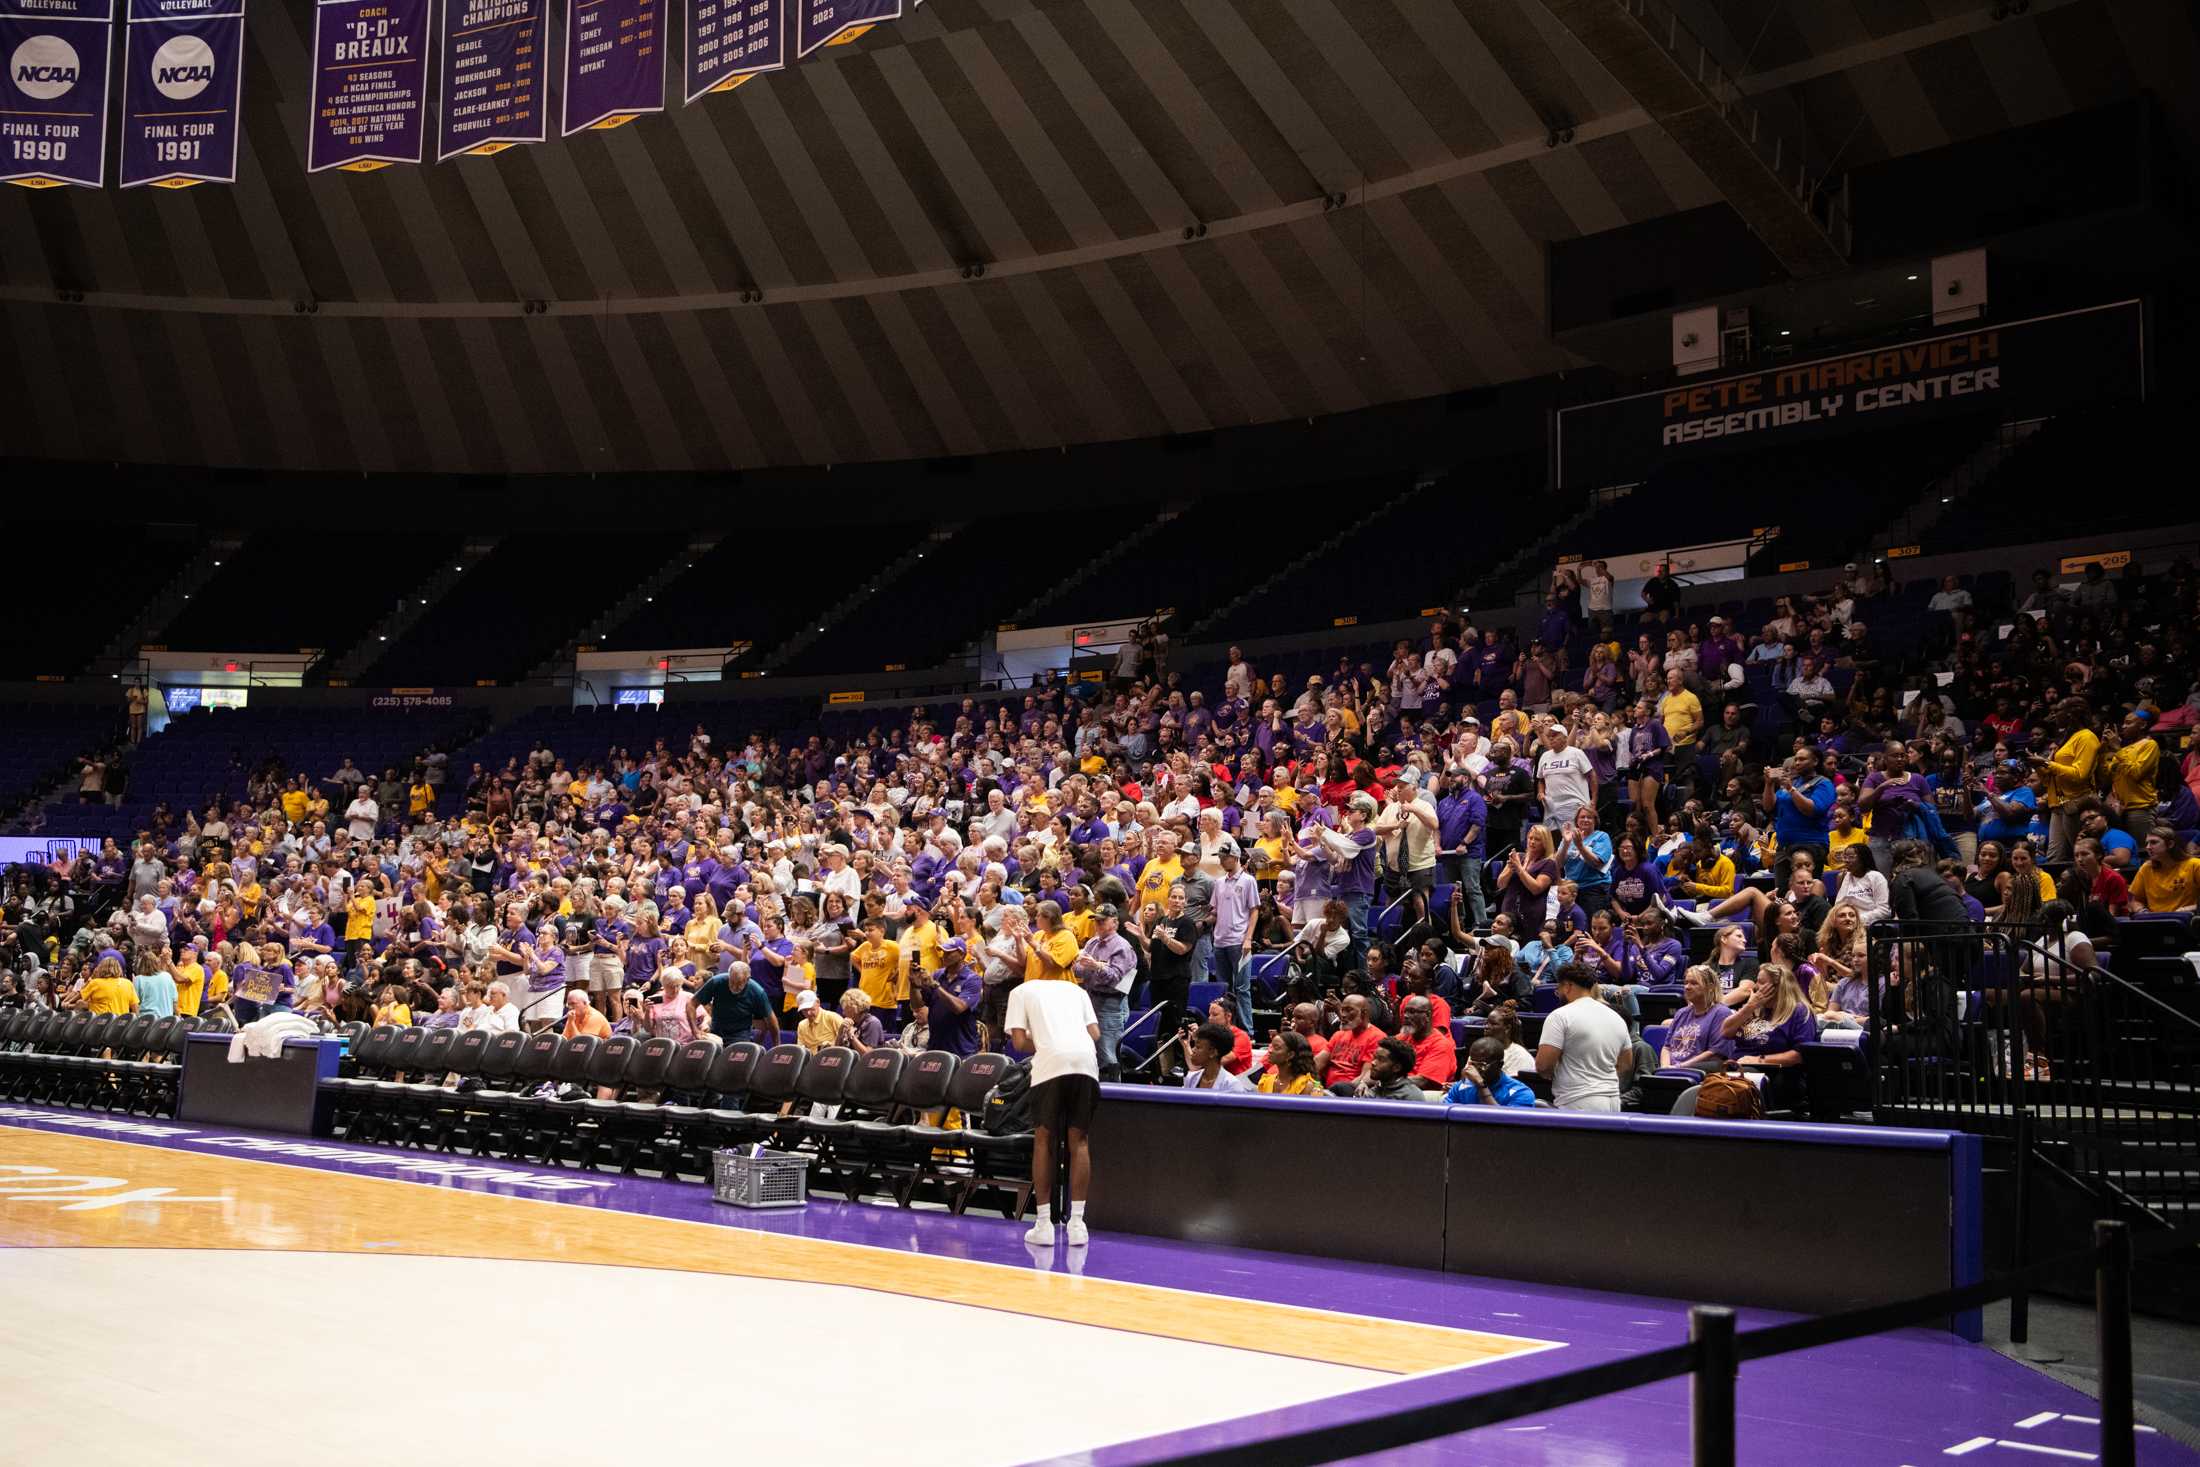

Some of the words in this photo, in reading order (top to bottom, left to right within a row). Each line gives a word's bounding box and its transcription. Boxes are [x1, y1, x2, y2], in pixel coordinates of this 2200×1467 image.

[20, 0, 77, 10] VOLLEYBALL
[160, 0, 212, 10] VOLLEYBALL
[698, 4, 717, 20] 1993
[360, 8, 387, 18] COACH
[463, 1, 528, 26] CHAMPIONS
[698, 22, 716, 38] 1997
[723, 11, 742, 28] 1998
[750, 0, 769, 16] 1999
[813, 7, 834, 26] 2023
[698, 39, 719, 56] 2000
[723, 28, 744, 46] 2002
[748, 18, 769, 36] 2003
[335, 36, 409, 60] BREAUX
[456, 40, 482, 53] BEADLE
[580, 40, 613, 58] FINNEGAN
[698, 56, 719, 73] 2004
[723, 46, 744, 64] 2005
[748, 36, 769, 53] 2006
[18, 65, 76, 83] NCAA
[158, 65, 211, 83] NCAA
[580, 59, 606, 74] BRYANT
[360, 70, 393, 81] SEASONS
[455, 67, 501, 85] BURKHOLDER
[350, 82, 369, 92] NCAA
[371, 81, 397, 90] FINALS
[454, 86, 487, 101] JACKSON
[335, 95, 349, 104] SEC
[351, 89, 411, 102] CHAMPIONSHIPS
[338, 103, 384, 116] ALL-AMERICA
[386, 101, 416, 111] HONORS
[453, 98, 510, 117] CLARE-KEARNEY
[371, 113, 405, 123] NATIONAL
[453, 117, 491, 133] COURVILLE
[3, 123, 40, 136] FINAL
[45, 124, 80, 138] FOUR
[144, 125, 178, 139] FINAL
[183, 123, 215, 137] FOUR
[333, 126, 357, 135] COACH
[358, 125, 367, 133] OF
[370, 124, 383, 132] THE
[385, 122, 404, 131] YEAR
[365, 134, 384, 143] WINS
[13, 140, 67, 161] 1990
[157, 141, 200, 161] 1991
[1664, 375, 1762, 417] PETE
[1776, 332, 2000, 397] MARAVICH
[1663, 394, 1843, 446] ASSEMBLY
[1855, 366, 2000, 412] CENTER
[372, 696, 401, 707] (225)
[403, 696, 453, 706] 578-4085
[1543, 760, 1570, 770] LSU
[687, 1049, 705, 1059] LSU
[727, 1052, 748, 1062] LSU
[772, 1054, 792, 1064] LSU
[820, 1056, 841, 1067] LSU
[868, 1058, 891, 1069] LSU
[919, 1061, 942, 1073] LSU
[970, 1063, 994, 1076] LSU
[184, 1137, 616, 1189] CHAMPIONS
